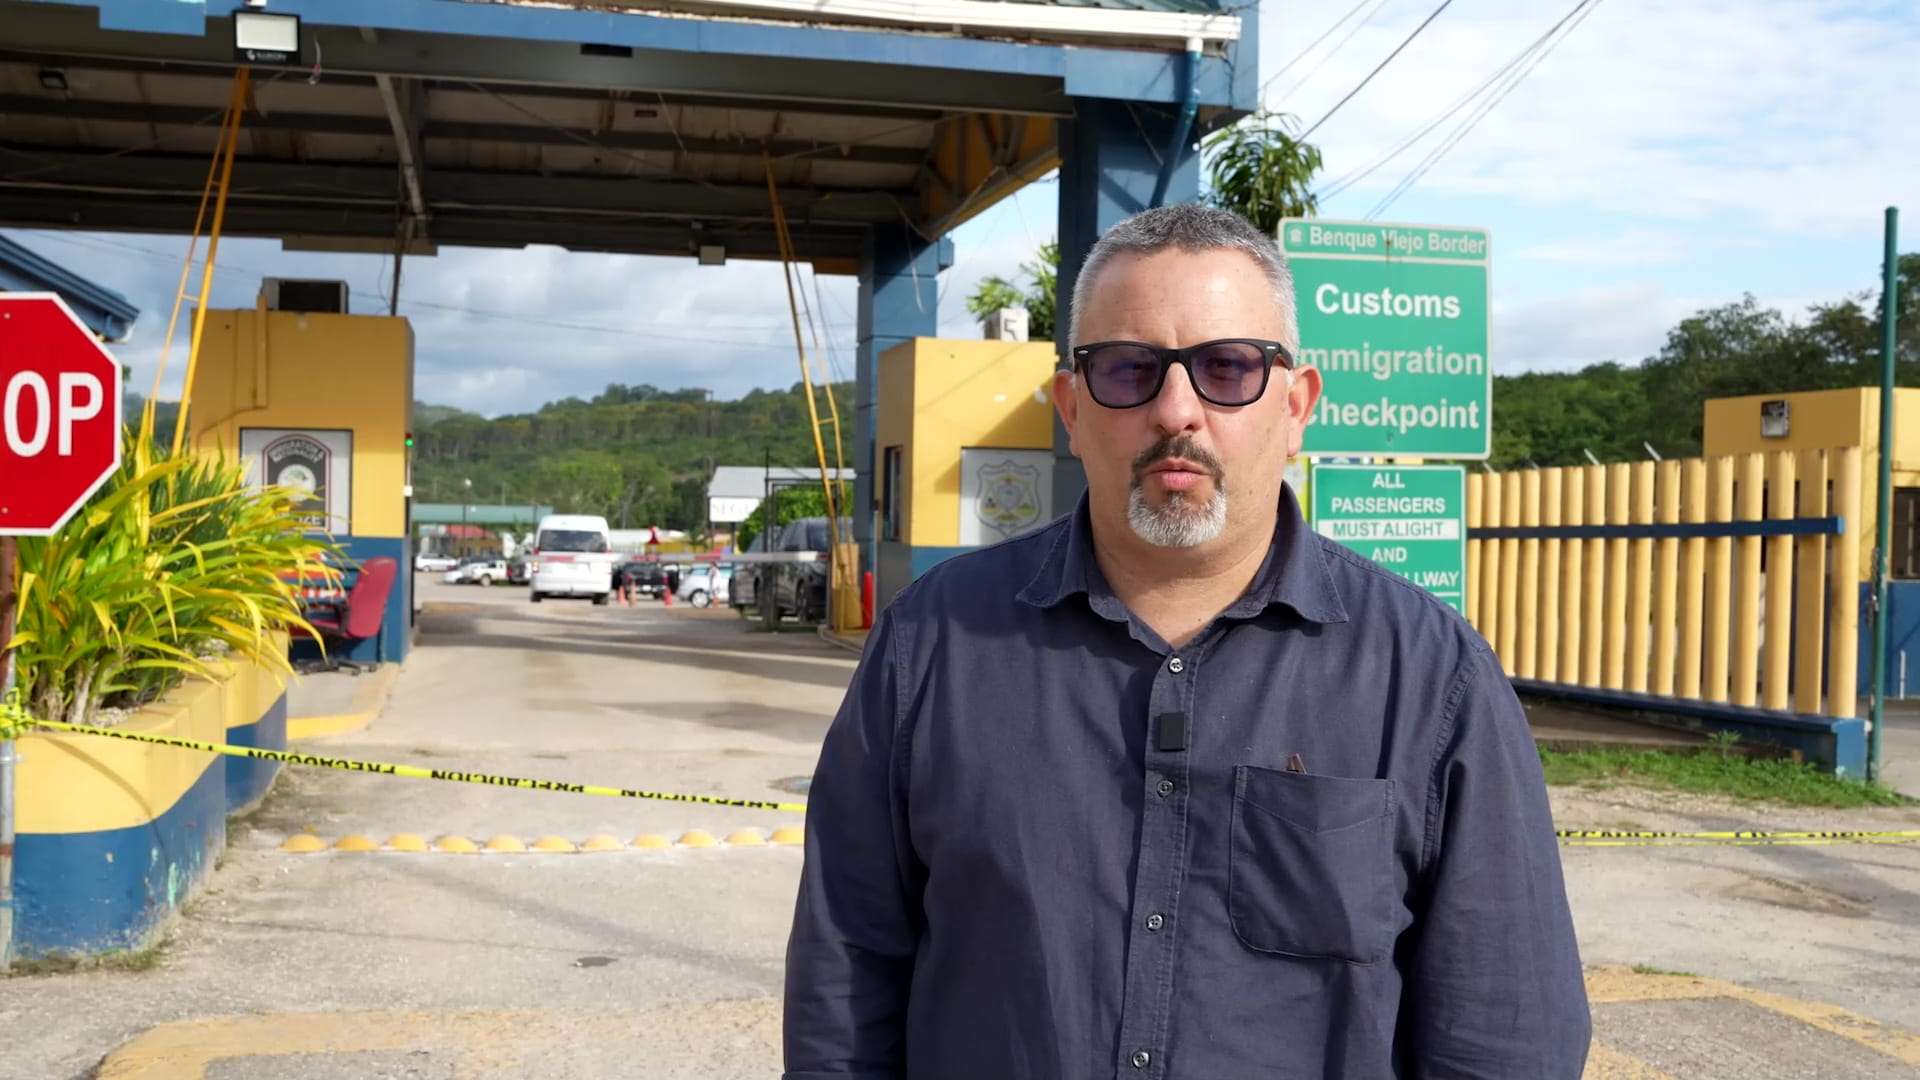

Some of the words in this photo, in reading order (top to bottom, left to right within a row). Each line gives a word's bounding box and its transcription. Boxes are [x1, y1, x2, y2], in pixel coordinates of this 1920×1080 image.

[1310, 226, 1377, 251] Benque
[1381, 228, 1424, 254] Viejo
[1428, 232, 1484, 254] Border
[1315, 283, 1461, 318] Customs
[1300, 342, 1483, 381] mmigration
[4, 370, 104, 457] OP
[1307, 395, 1480, 434] heckpoint
[1372, 472, 1406, 489] ALL
[1331, 497, 1446, 514] PASSENGERS
[1333, 522, 1380, 537] MUST
[1383, 521, 1443, 537] ALIGHT
[1371, 547, 1408, 563] AND
